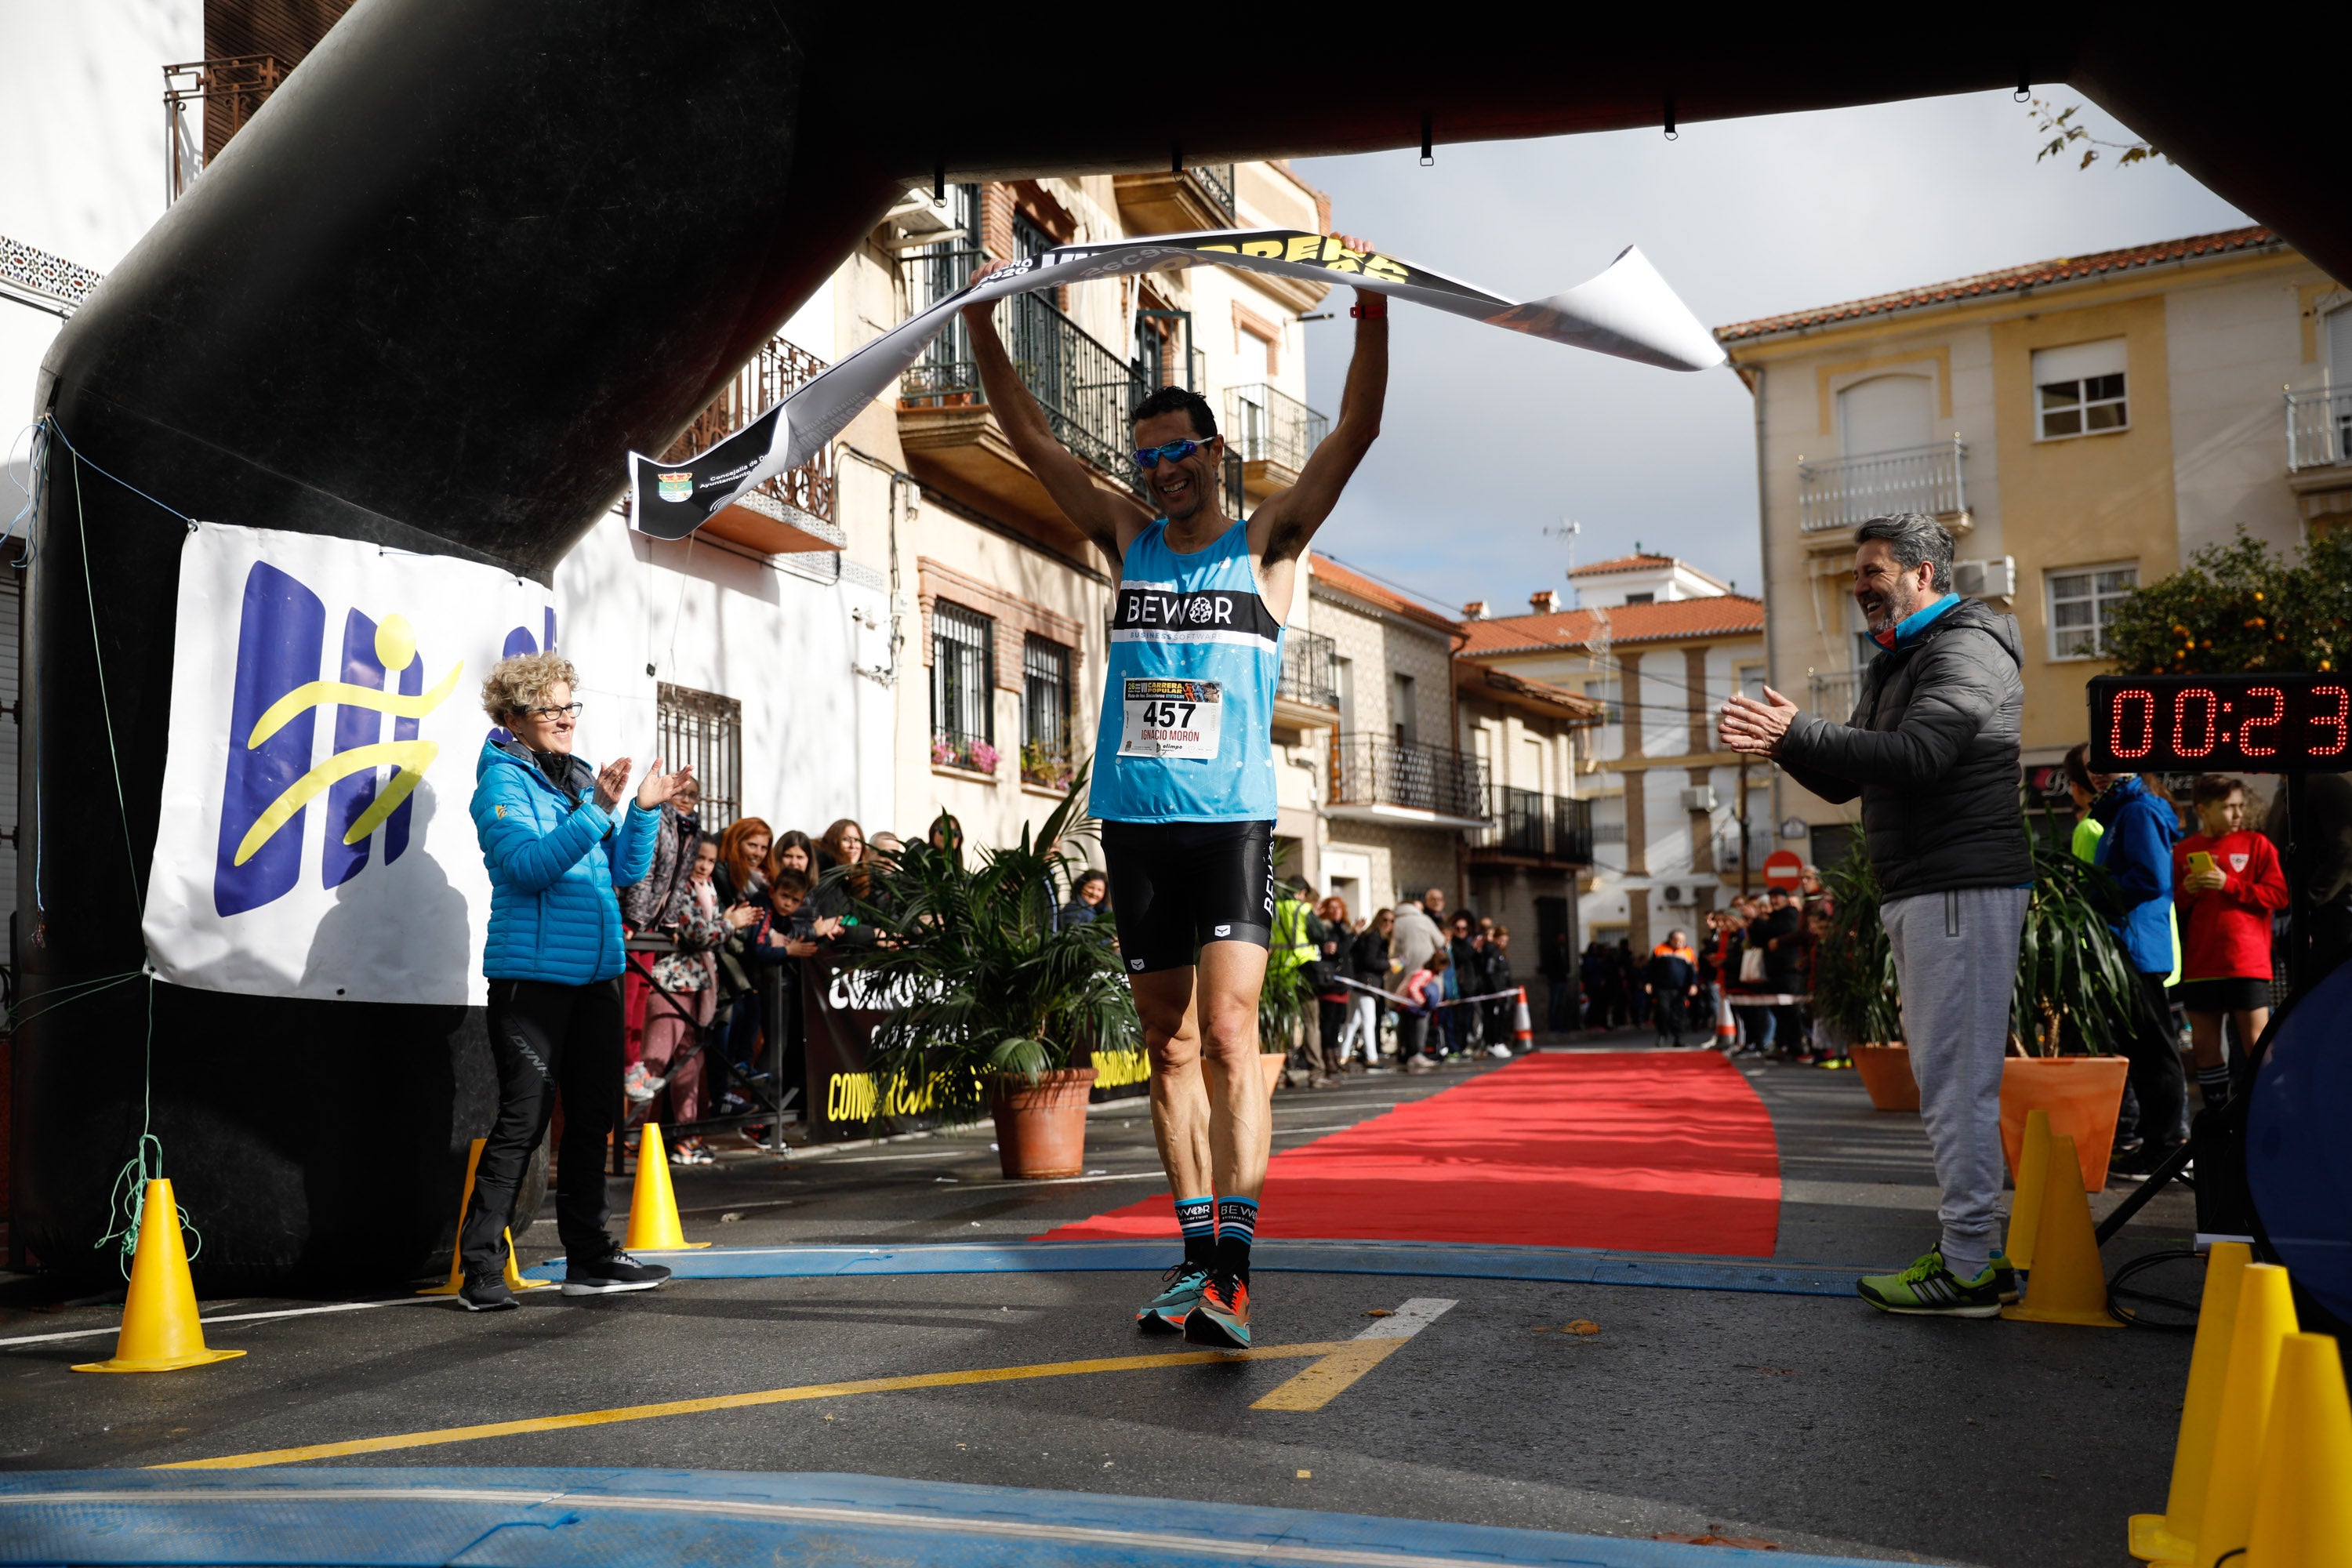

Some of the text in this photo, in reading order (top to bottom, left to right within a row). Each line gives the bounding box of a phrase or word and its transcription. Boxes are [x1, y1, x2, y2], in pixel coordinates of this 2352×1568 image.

[699, 470, 751, 489] Ayuntamiento
[1143, 702, 1196, 728] 457
[1141, 729, 1200, 742] IGNACIO MORÓN
